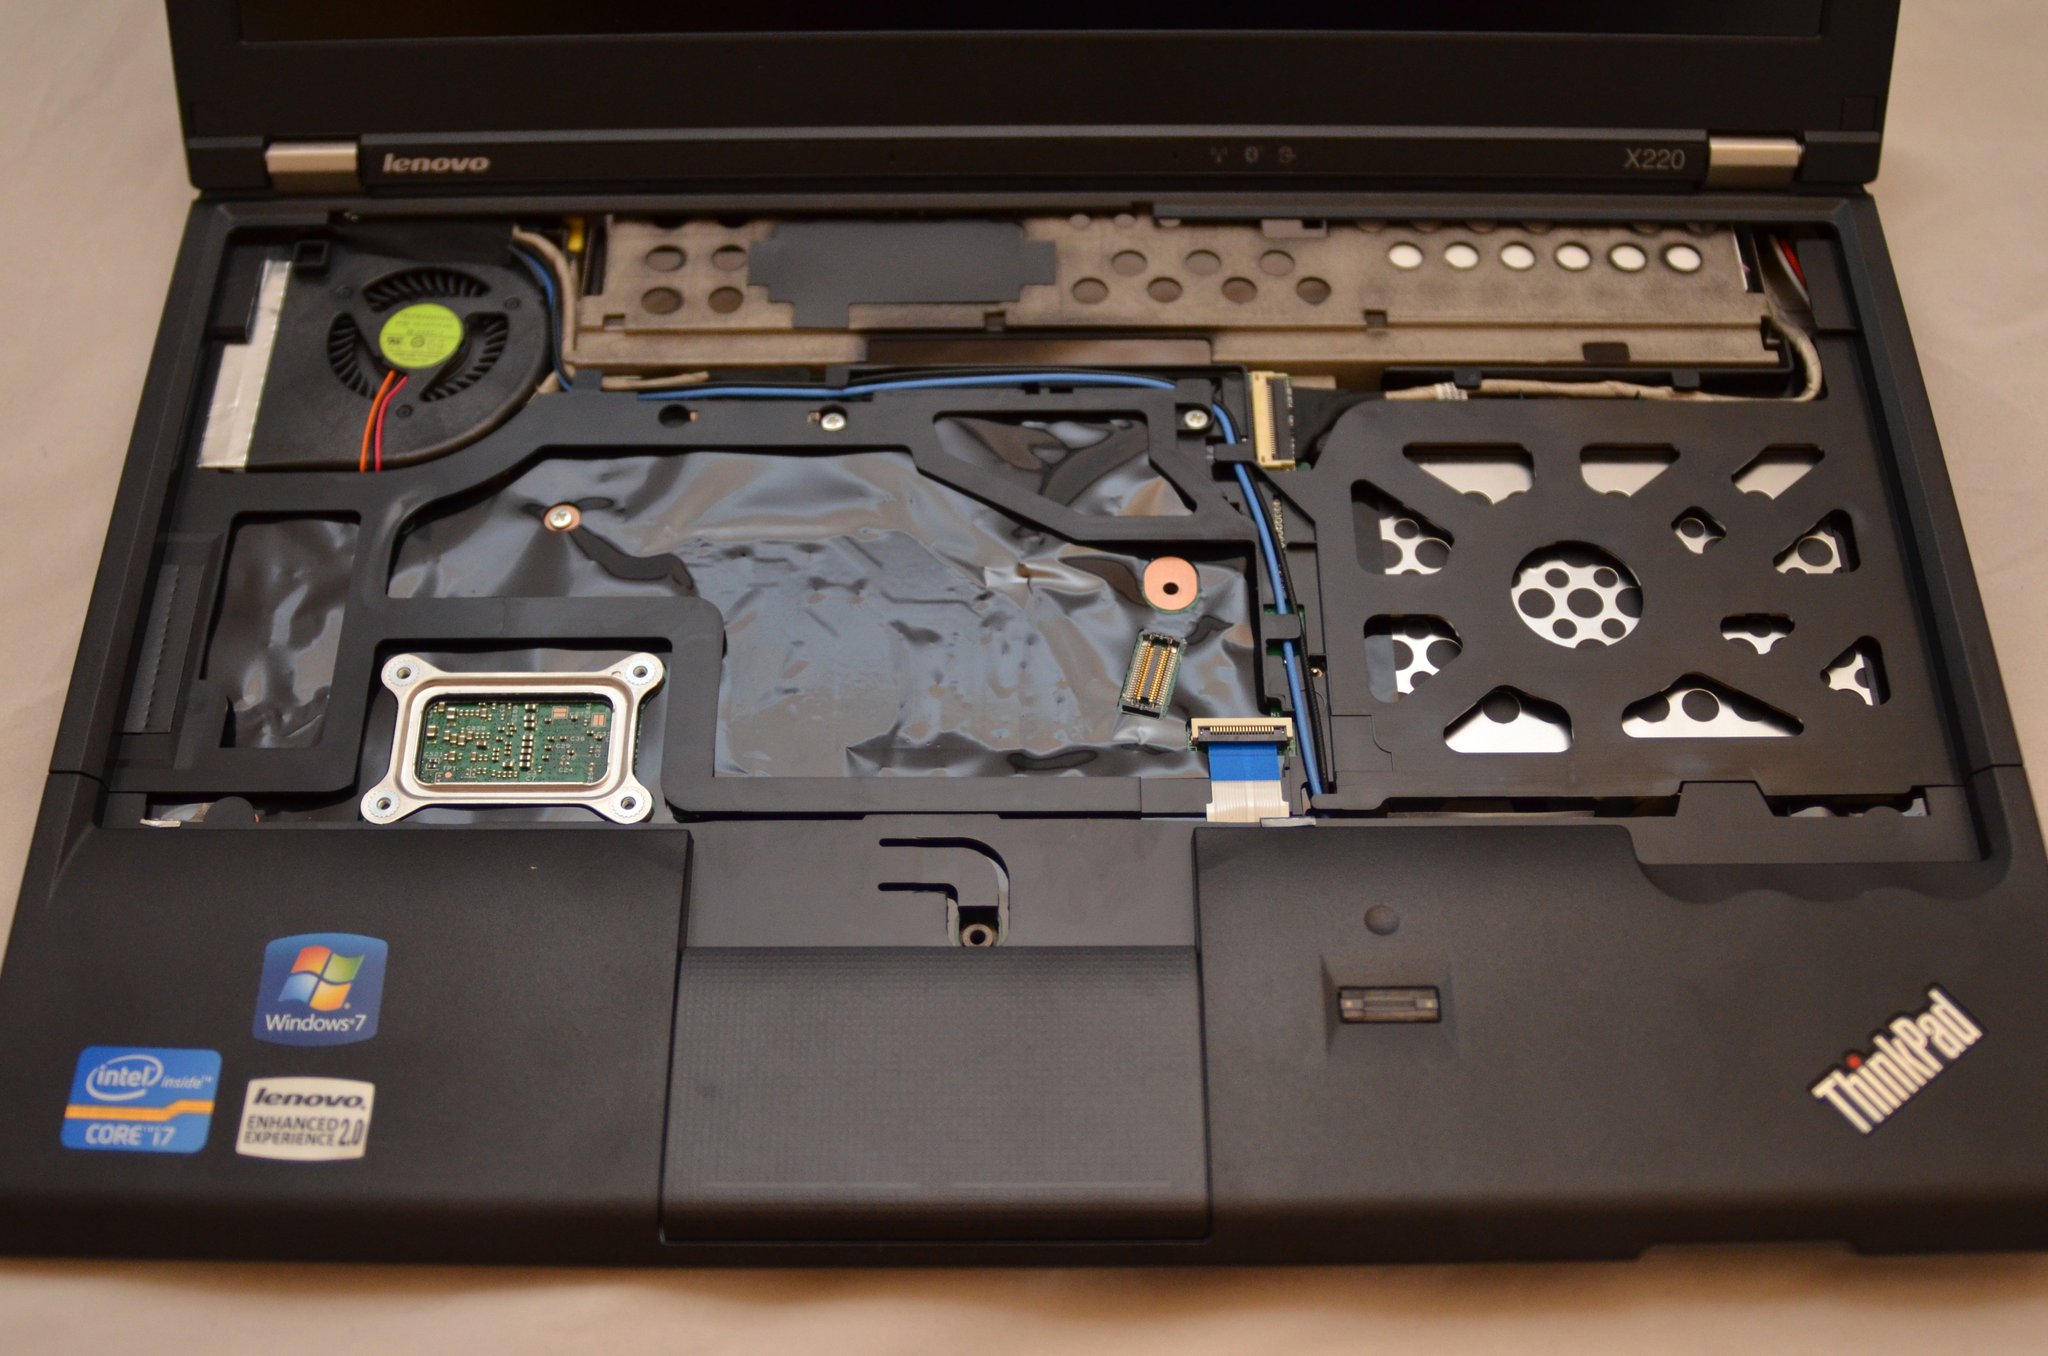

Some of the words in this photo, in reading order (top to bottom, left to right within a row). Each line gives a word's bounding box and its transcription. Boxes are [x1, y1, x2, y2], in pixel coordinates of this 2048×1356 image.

[382, 152, 490, 173] lenovo
[1624, 148, 1686, 170] X220
[355, 1014, 367, 1032] 7
[1811, 987, 1984, 1135] ThinkPad
[96, 1063, 151, 1087] intel
[246, 1115, 339, 1132] ENHANCED
[338, 1118, 365, 1147] 2.0
[152, 1125, 176, 1147] i7
[244, 1131, 335, 1146] EXPERIENCE
